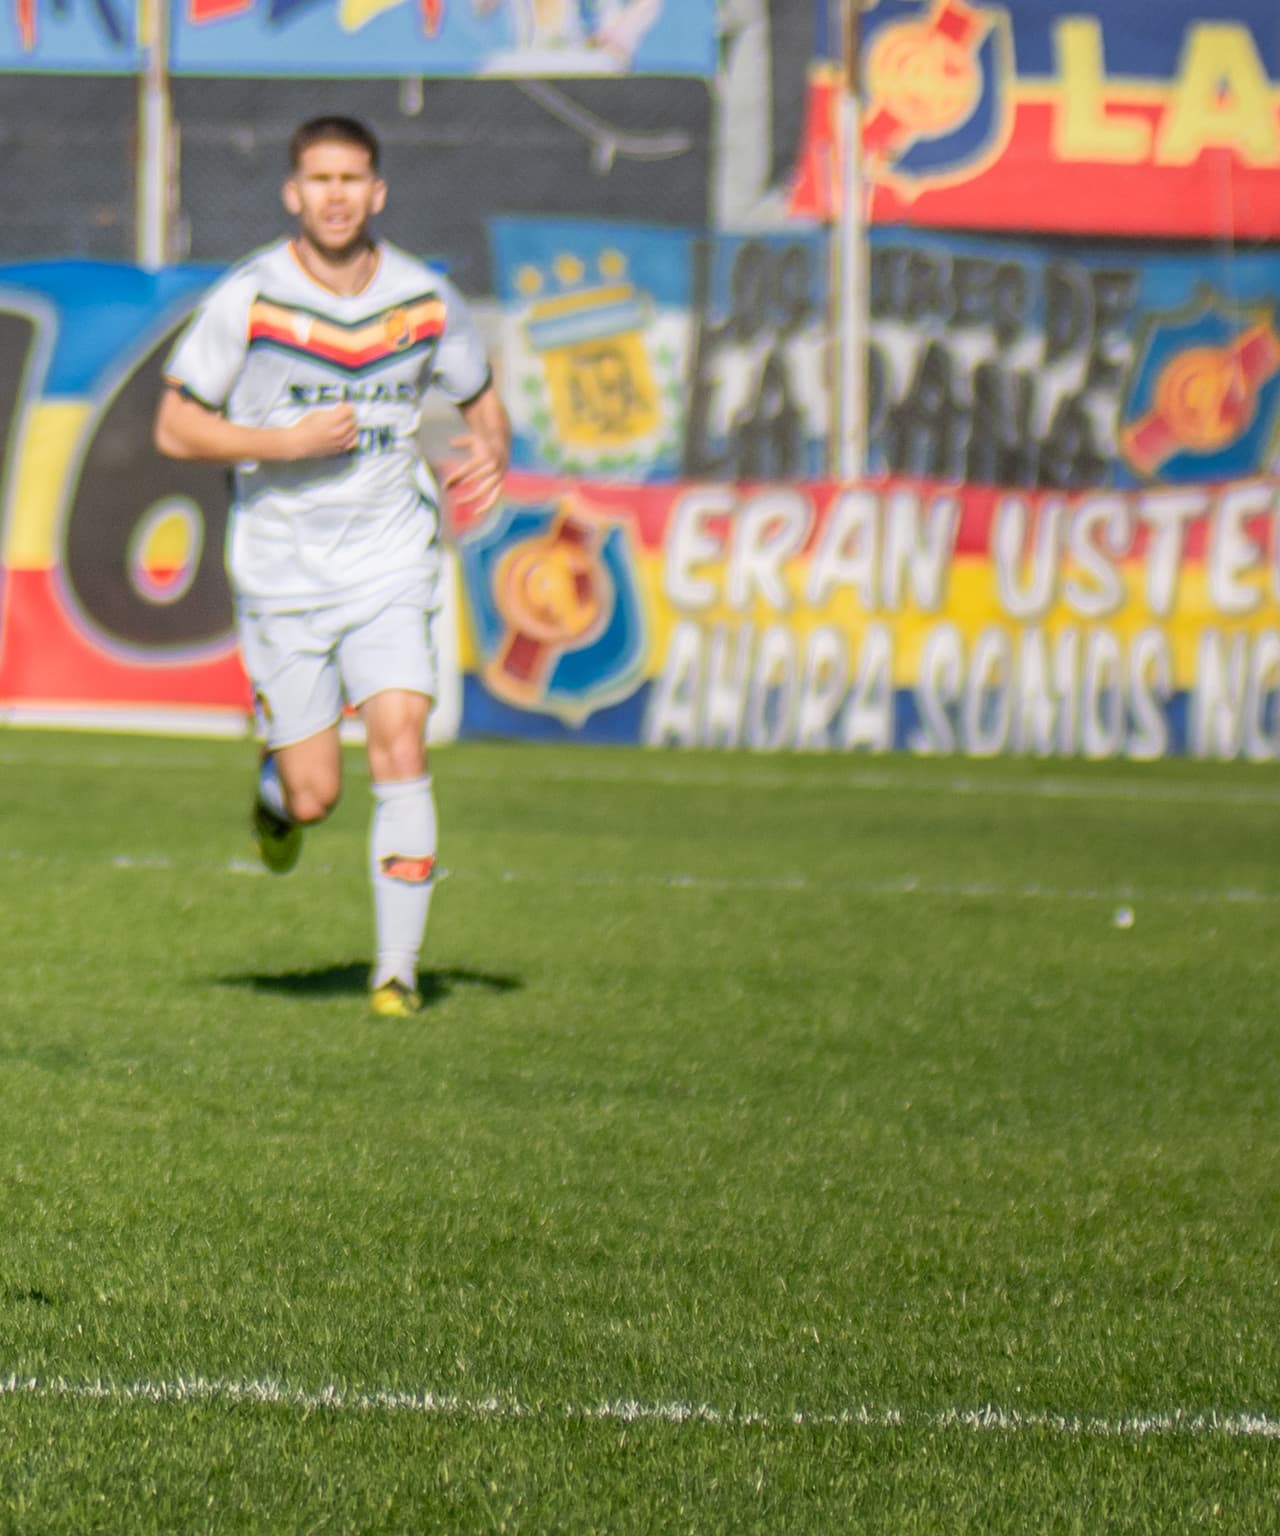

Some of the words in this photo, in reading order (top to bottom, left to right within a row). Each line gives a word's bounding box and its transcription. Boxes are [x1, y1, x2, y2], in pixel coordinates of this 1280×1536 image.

[1053, 13, 1277, 166] LA
[665, 486, 959, 614] ERAN
[991, 482, 1280, 618] USTE
[646, 620, 894, 751] AHORA
[913, 622, 1172, 760] SOMOS
